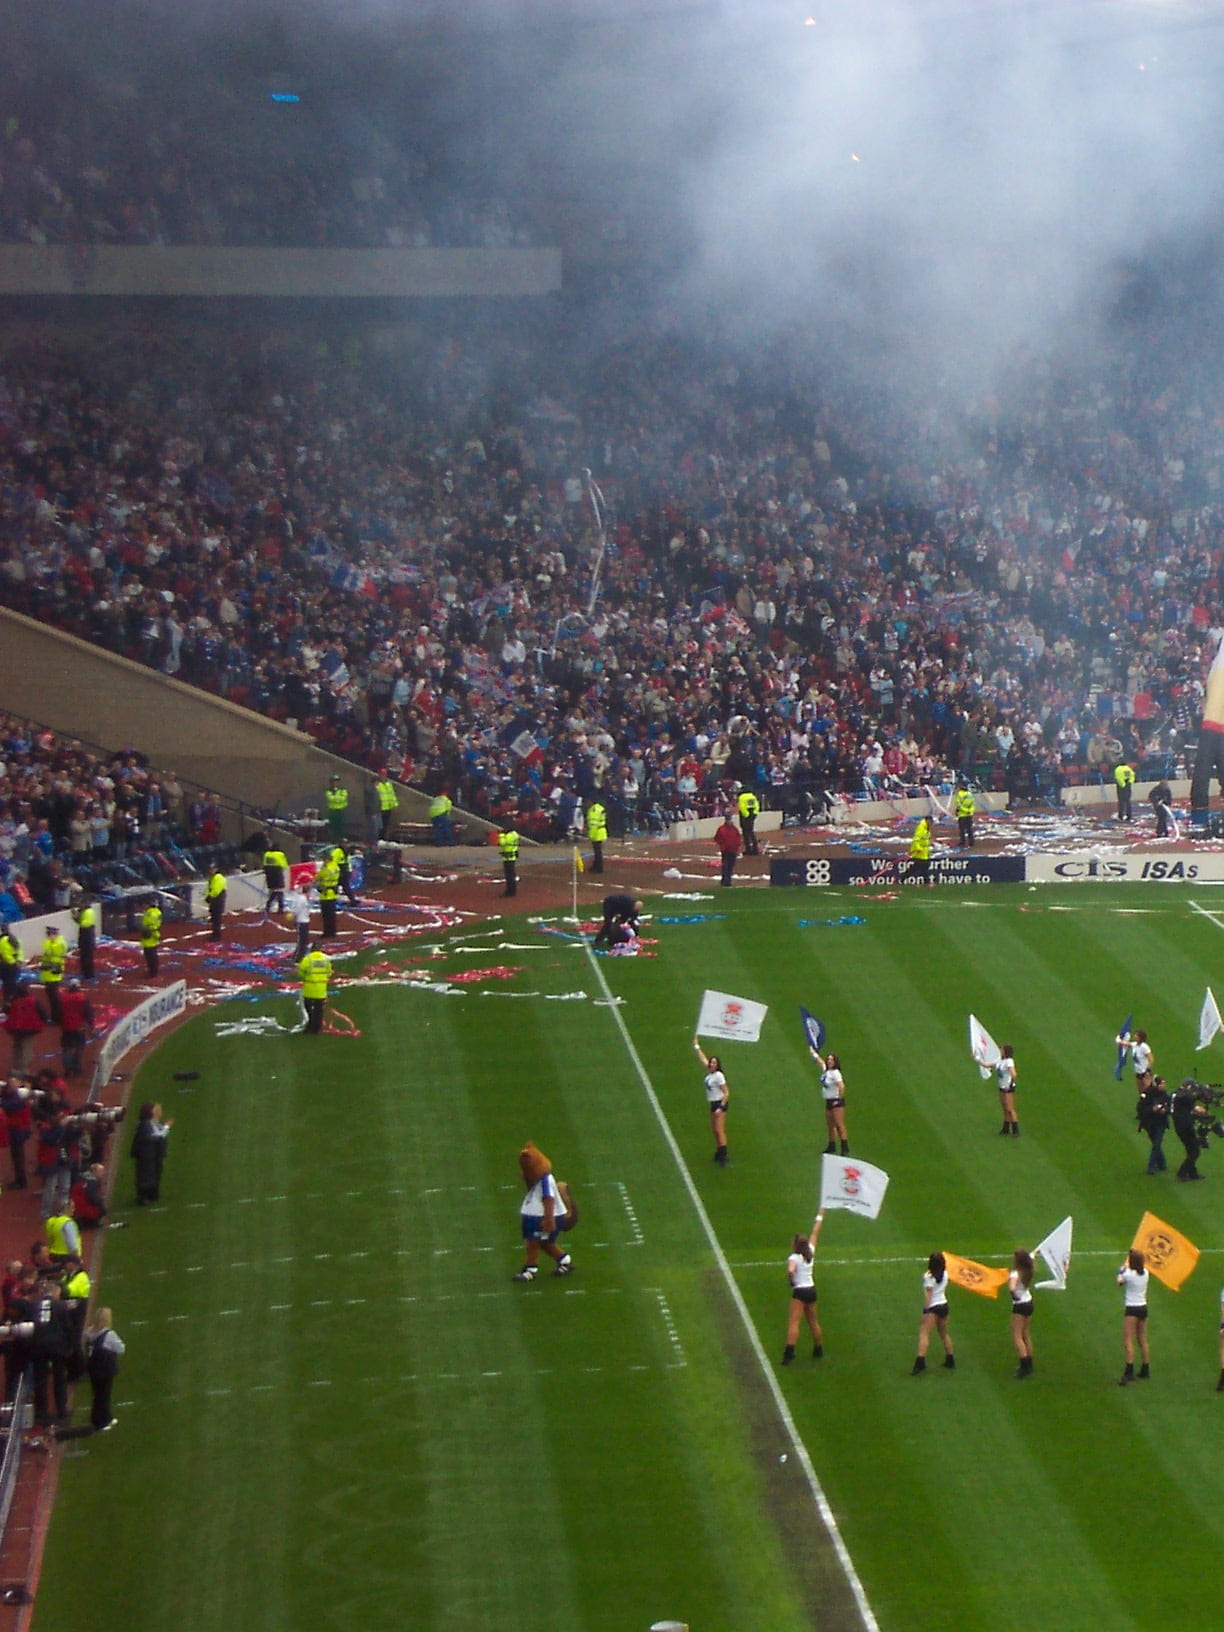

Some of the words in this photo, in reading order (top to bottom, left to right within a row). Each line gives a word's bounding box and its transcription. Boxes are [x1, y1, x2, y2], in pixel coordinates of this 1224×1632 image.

[871, 859, 894, 871] We
[926, 857, 969, 870] urther
[1054, 858, 1128, 877] CIS
[849, 876, 865, 886] so
[868, 875, 895, 886] you
[939, 872, 973, 885] have
[976, 873, 991, 885] to
